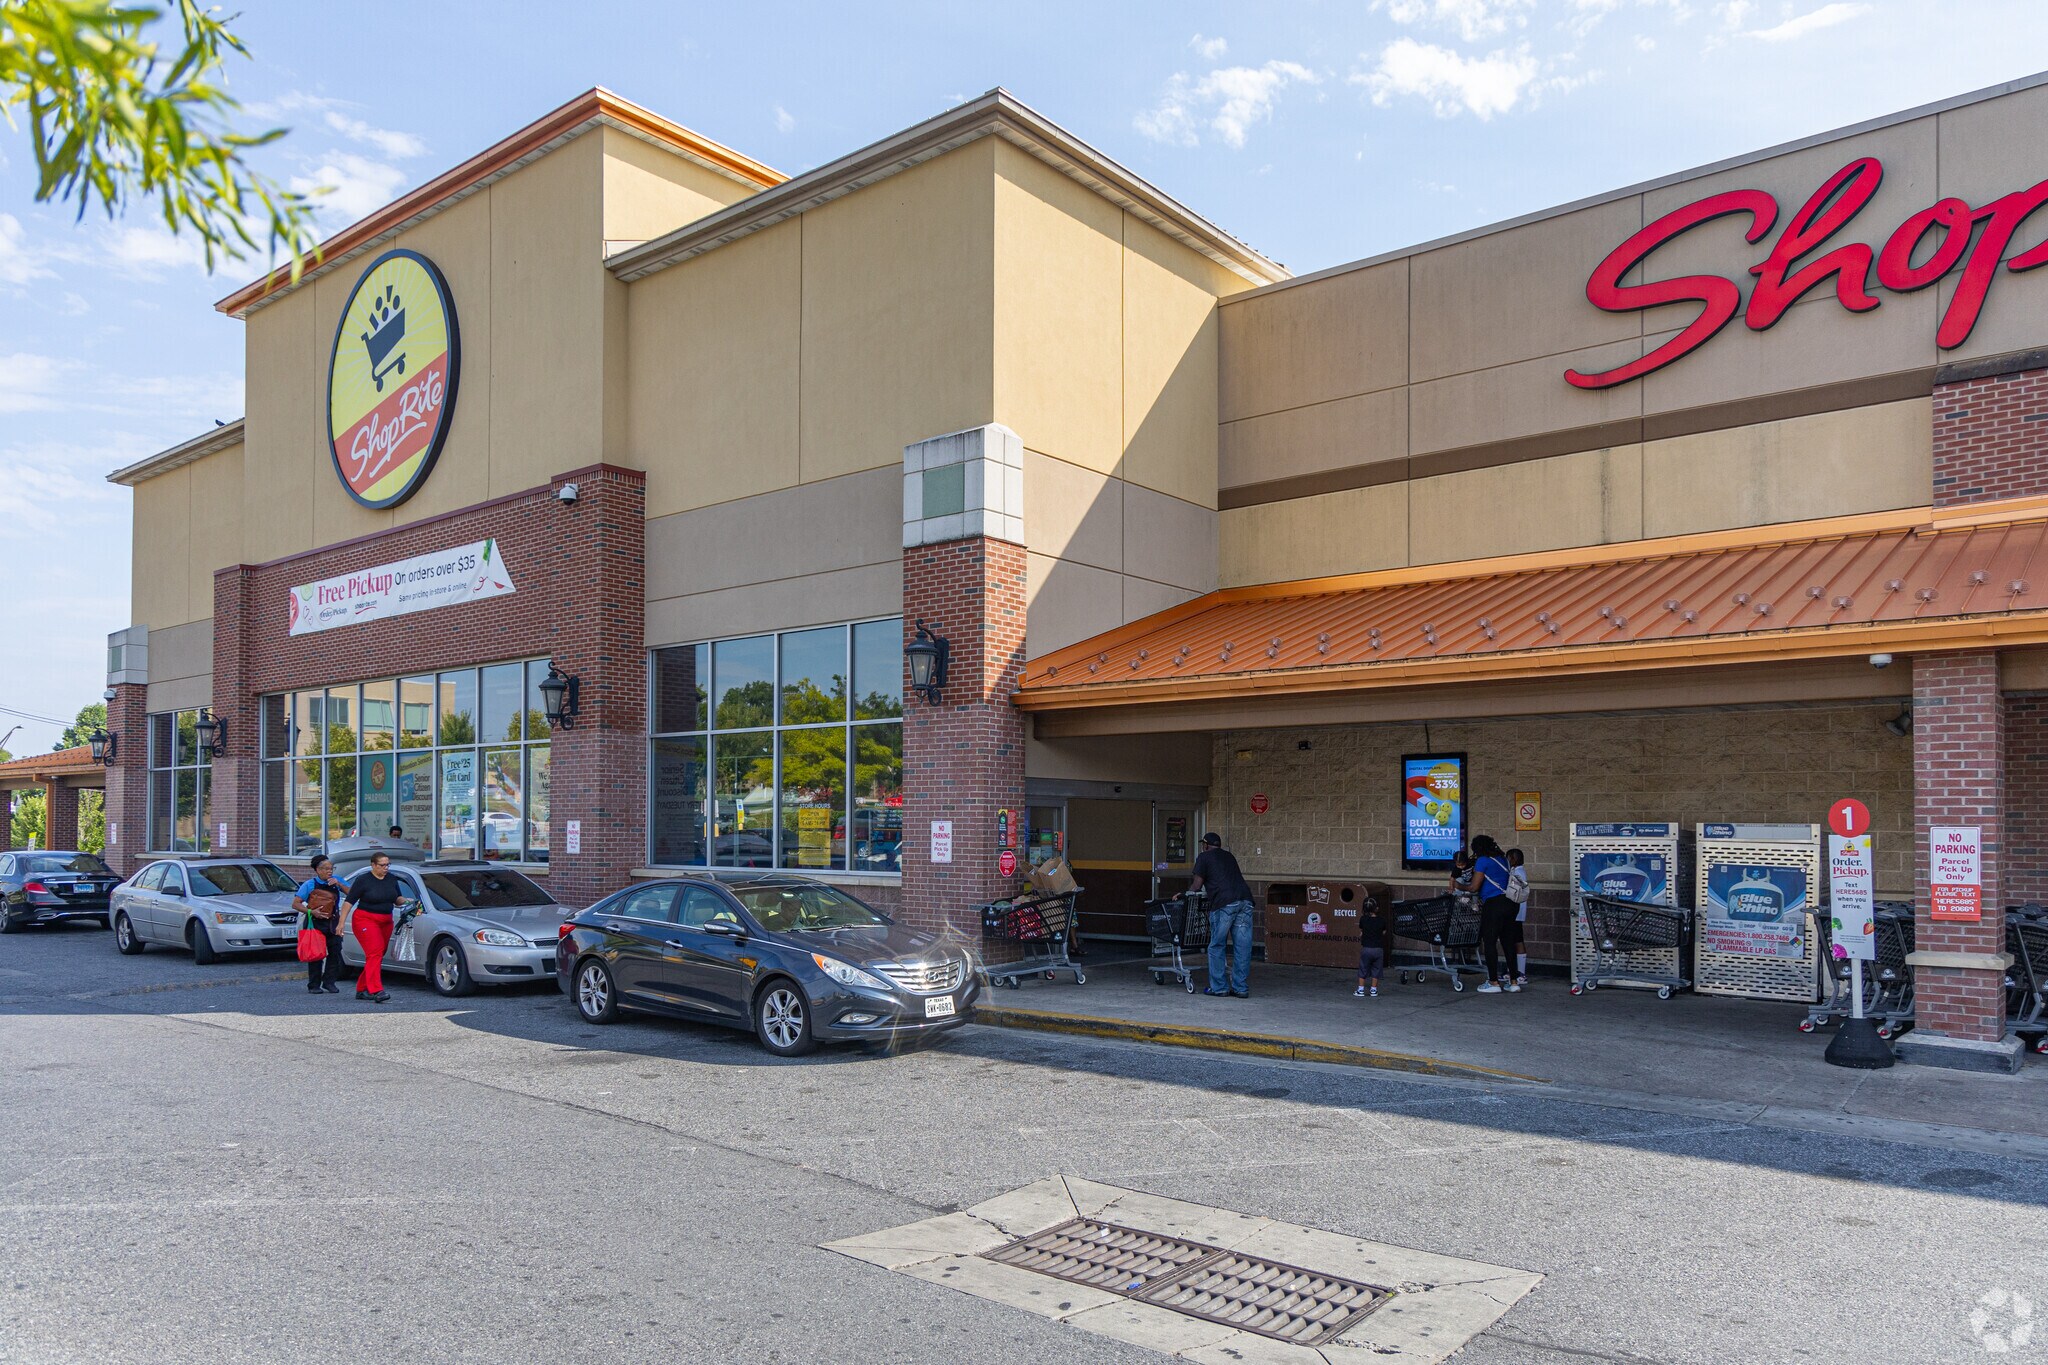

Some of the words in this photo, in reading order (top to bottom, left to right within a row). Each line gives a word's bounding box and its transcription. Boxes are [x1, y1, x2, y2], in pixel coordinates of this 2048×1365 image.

[350, 370, 444, 482] ShopRite
[318, 585, 345, 605] Free
[348, 572, 393, 598] Pickup
[394, 571, 406, 585] On
[408, 565, 434, 583] orders
[436, 561, 455, 577] over
[457, 554, 476, 573] $35
[398, 594, 411, 603] Same
[412, 590, 429, 601] pricing
[452, 582, 467, 592] online
[446, 759, 461, 769] Free
[414, 773, 430, 782] Senior
[446, 773, 457, 782] Gift
[458, 771, 471, 782] Card
[414, 783, 431, 792] Citizen
[1409, 819, 1440, 827] BUILD
[1841, 806, 1853, 831] 1
[1409, 828, 1457, 836] LOYALTY!
[1949, 833, 1962, 842] NO
[1935, 844, 1976, 854] PARKING
[1832, 857, 1863, 866] Order.
[1833, 866, 1869, 877] Pickup.
[1961, 866, 1973, 874] Up
[1603, 879, 1627, 888] Blue
[1835, 888, 1868, 896] HERE5685
[1740, 893, 1773, 904] Blue
[1278, 906, 1296, 914] TRASH
[1334, 909, 1357, 917] RECYCLE
[1736, 903, 1779, 915] Rhino
[1270, 932, 1302, 940] SHOPRITE
[1312, 934, 1342, 942] HOWARD
[1717, 938, 1745, 946] SMOKING
[1715, 944, 1753, 953] FLAMMABLE
